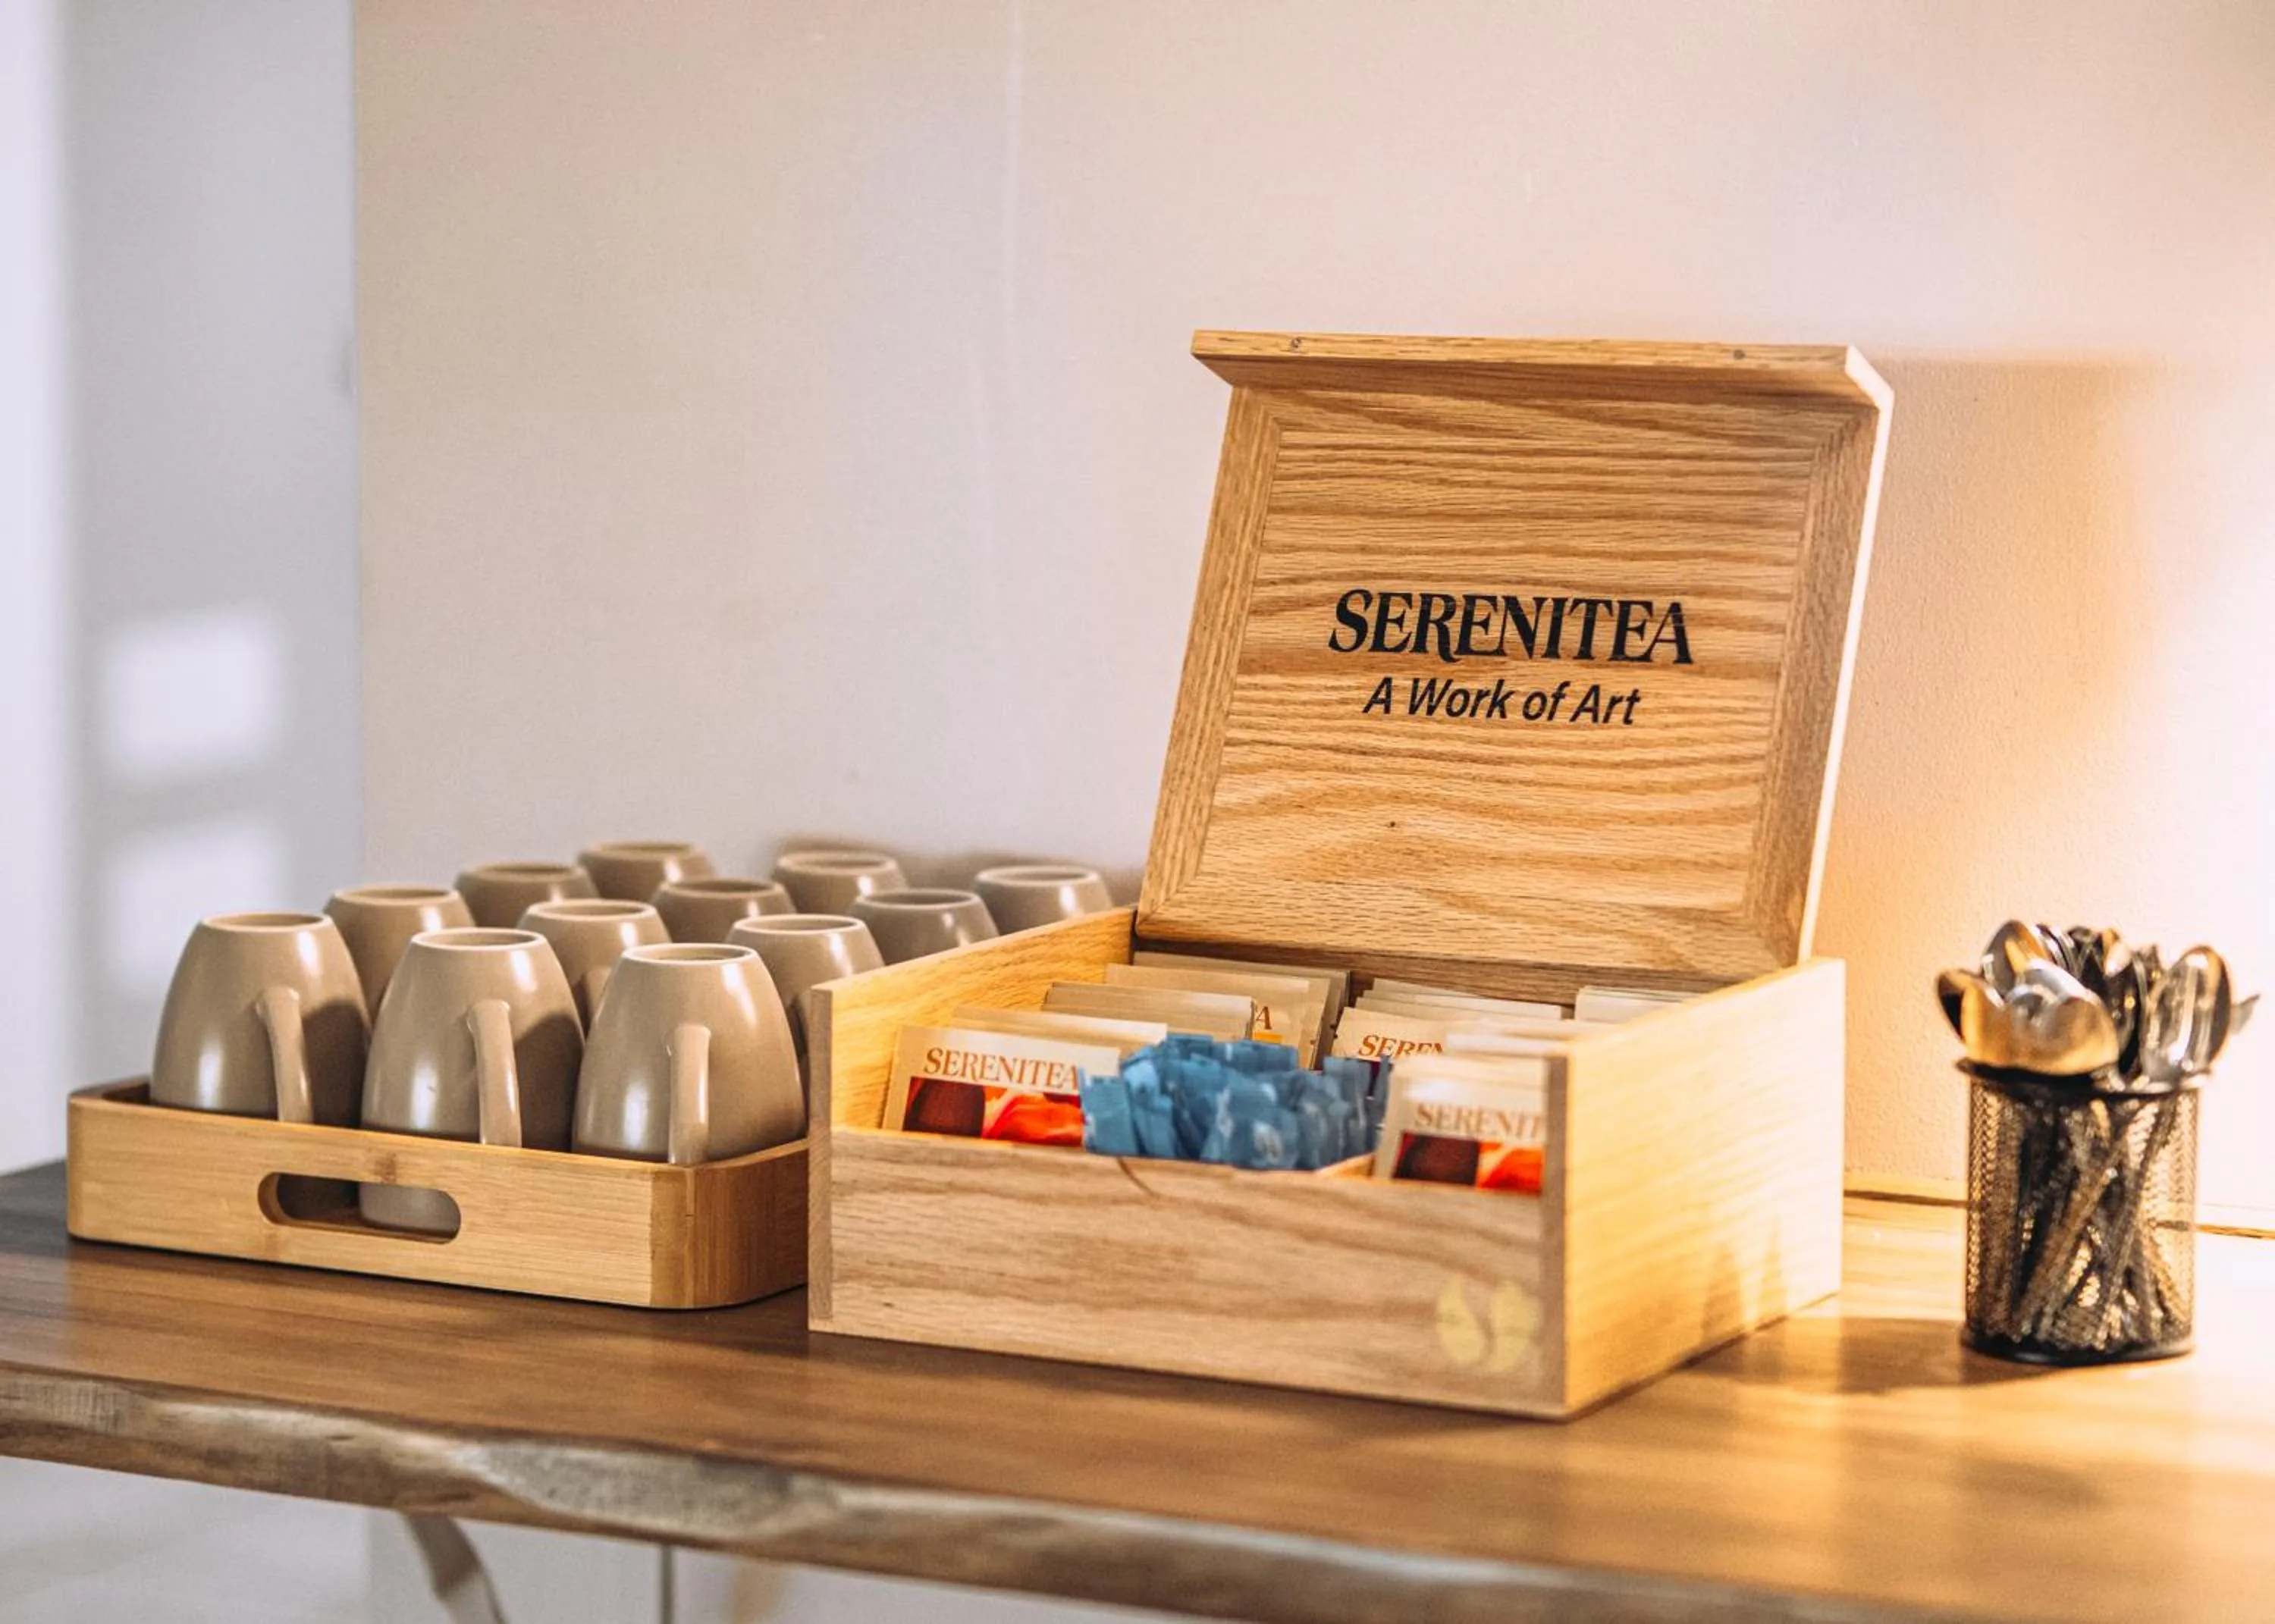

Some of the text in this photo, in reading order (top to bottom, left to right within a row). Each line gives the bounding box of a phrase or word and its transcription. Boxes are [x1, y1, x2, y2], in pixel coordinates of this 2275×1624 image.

[1328, 588, 1693, 665] SERENITEA
[1363, 676, 1641, 726] A Work of Art
[924, 1046, 1078, 1091] SERENITEA
